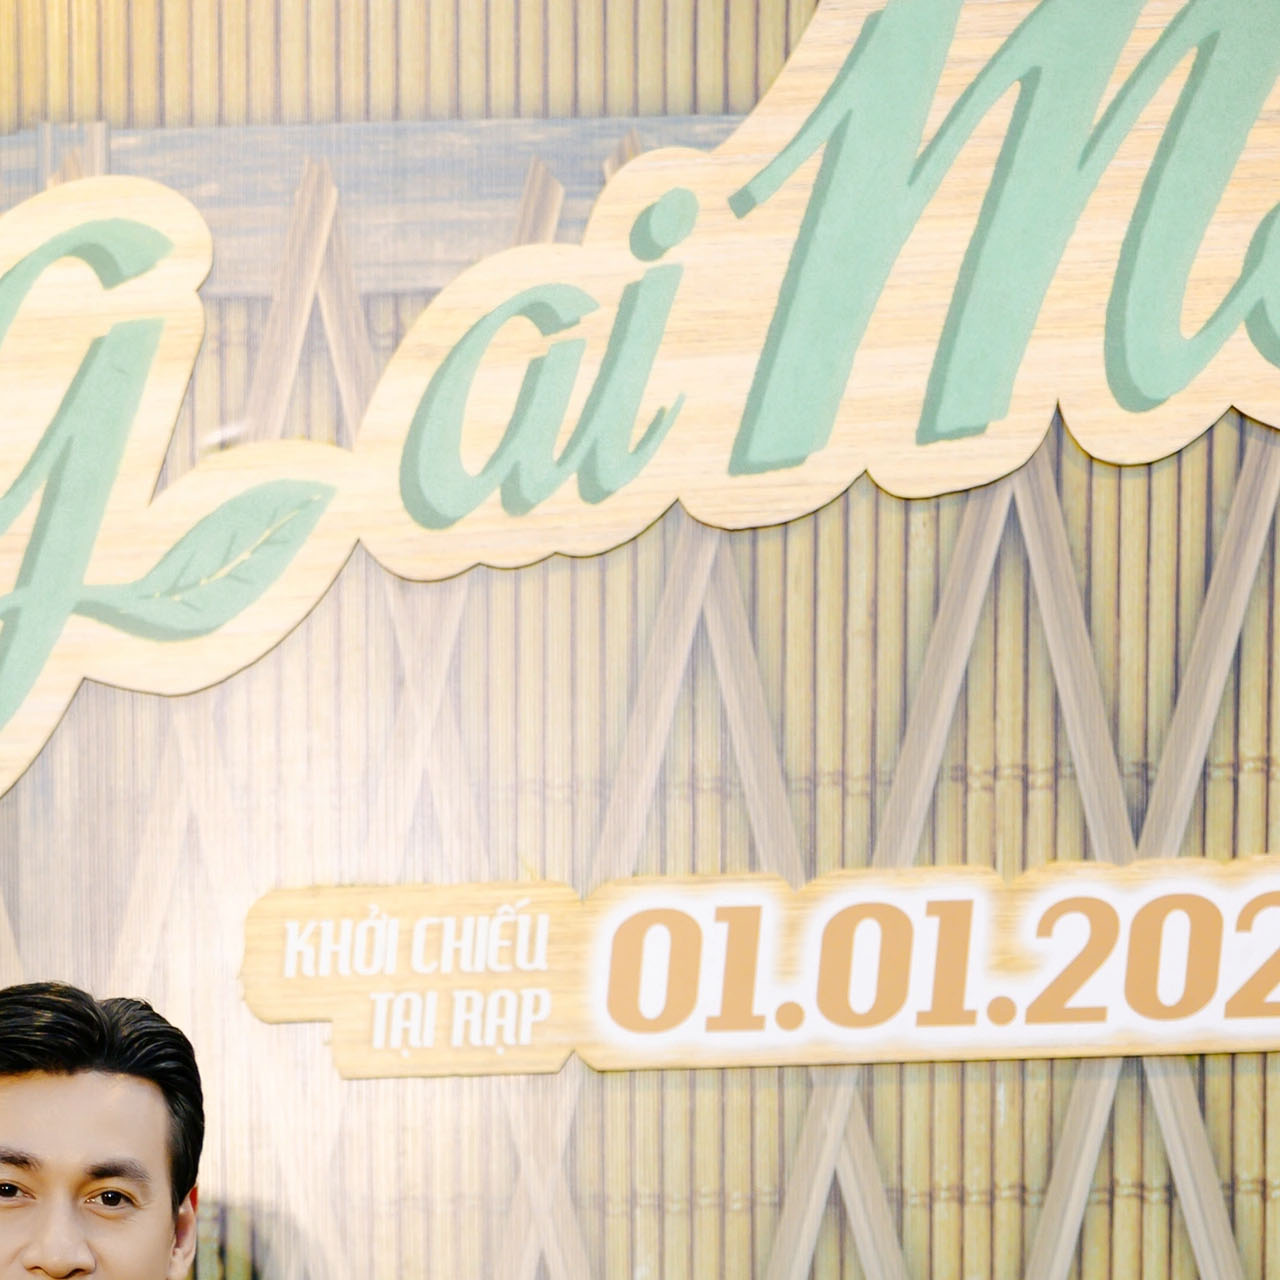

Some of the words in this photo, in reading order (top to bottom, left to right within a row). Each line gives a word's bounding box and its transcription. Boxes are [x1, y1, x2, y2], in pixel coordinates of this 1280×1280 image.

[399, 187, 700, 530] ai
[727, 0, 1280, 475] M
[283, 903, 399, 978] KHỞI
[411, 897, 550, 974] CHIẾU
[369, 989, 438, 1058] TẠI
[450, 988, 552, 1055] RẠP
